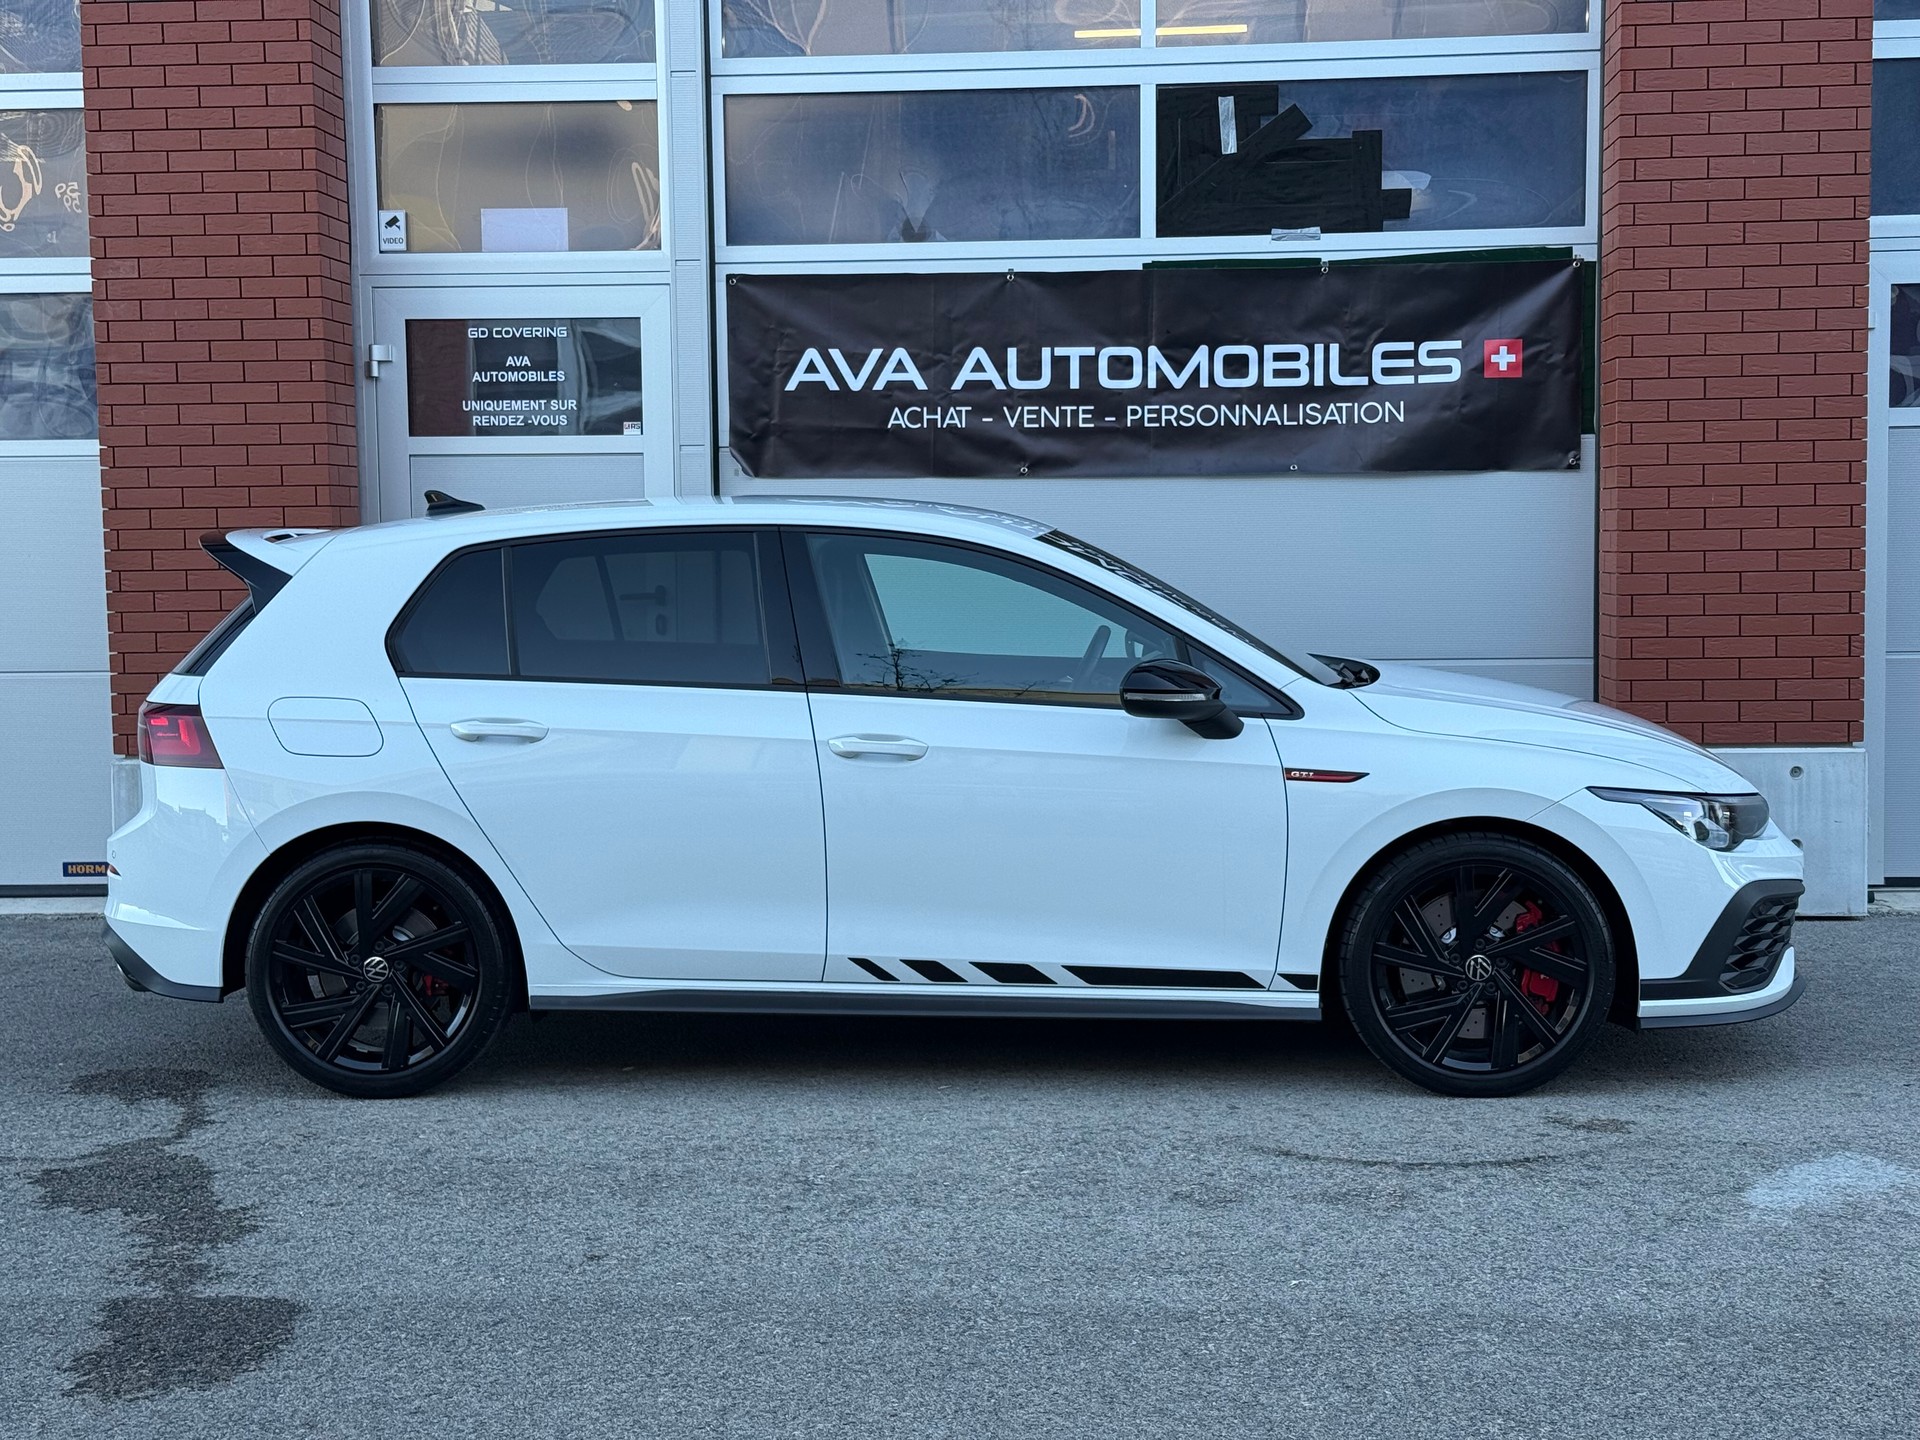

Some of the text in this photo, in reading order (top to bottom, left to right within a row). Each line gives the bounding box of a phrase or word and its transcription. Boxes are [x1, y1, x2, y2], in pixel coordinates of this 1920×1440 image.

[382, 237, 404, 245] VIDEO
[467, 326, 568, 339] GD COVERING
[505, 355, 532, 367] AVA
[784, 339, 1463, 392] AVA AUTOMOBILES
[472, 370, 566, 383] AUTOMOBILES
[462, 399, 578, 412] UNIQUEMENT SUR
[472, 415, 525, 427] RENDEZ
[887, 406, 972, 429] ACHAT
[1002, 405, 1095, 428] VENTE
[1126, 400, 1405, 428] PERSONNALISATION
[1290, 771, 1315, 779] GTI
